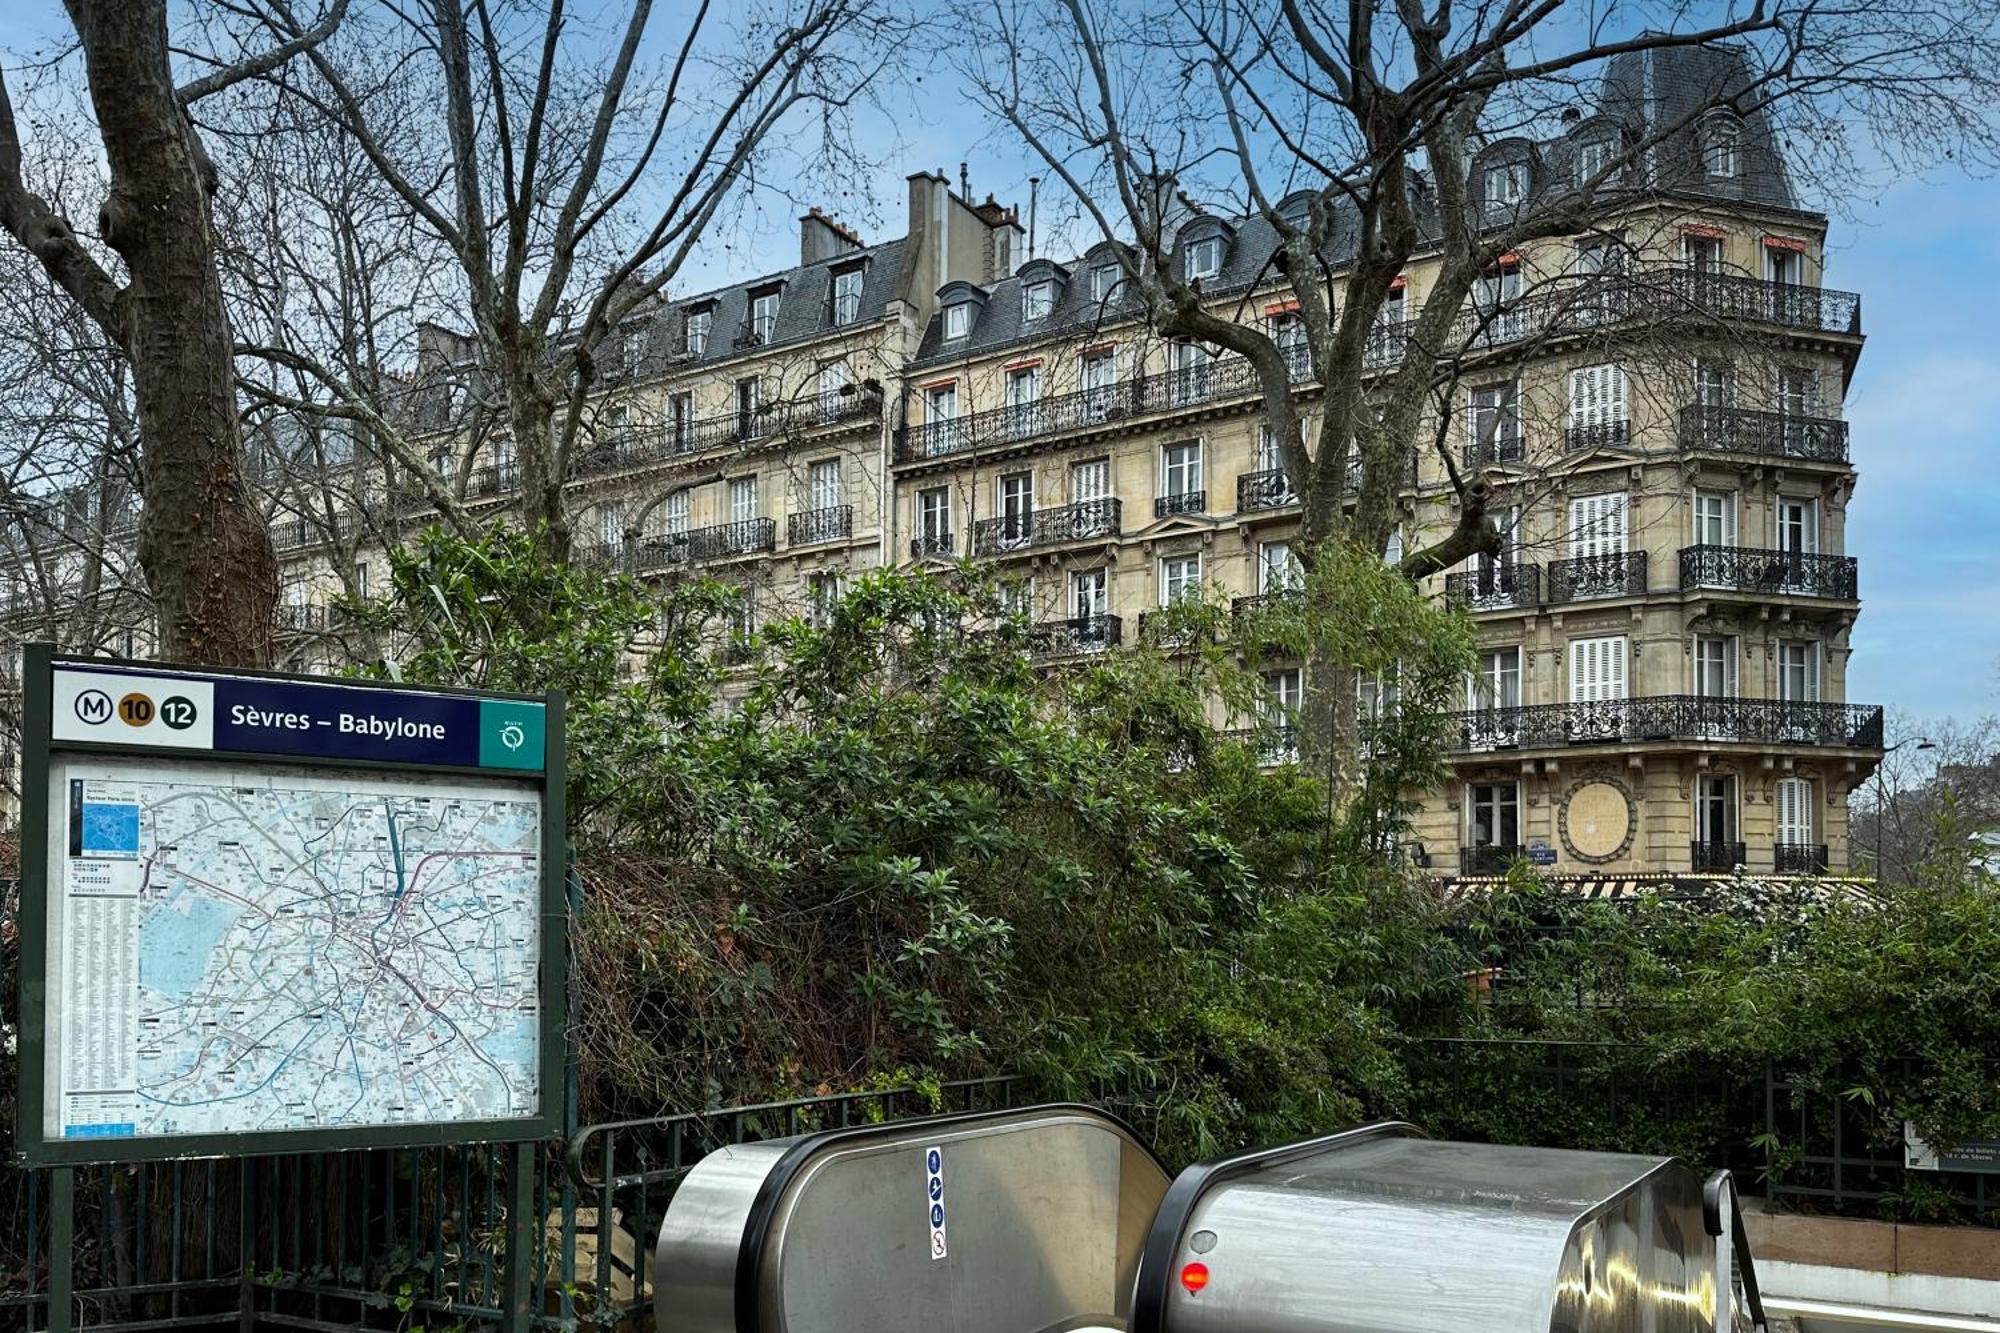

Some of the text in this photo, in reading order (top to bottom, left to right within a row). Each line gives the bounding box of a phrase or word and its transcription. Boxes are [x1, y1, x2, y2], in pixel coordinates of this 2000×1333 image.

[84, 697, 192, 724] M 10 12
[231, 704, 310, 730] Sèvres
[339, 713, 446, 740] Babylone
